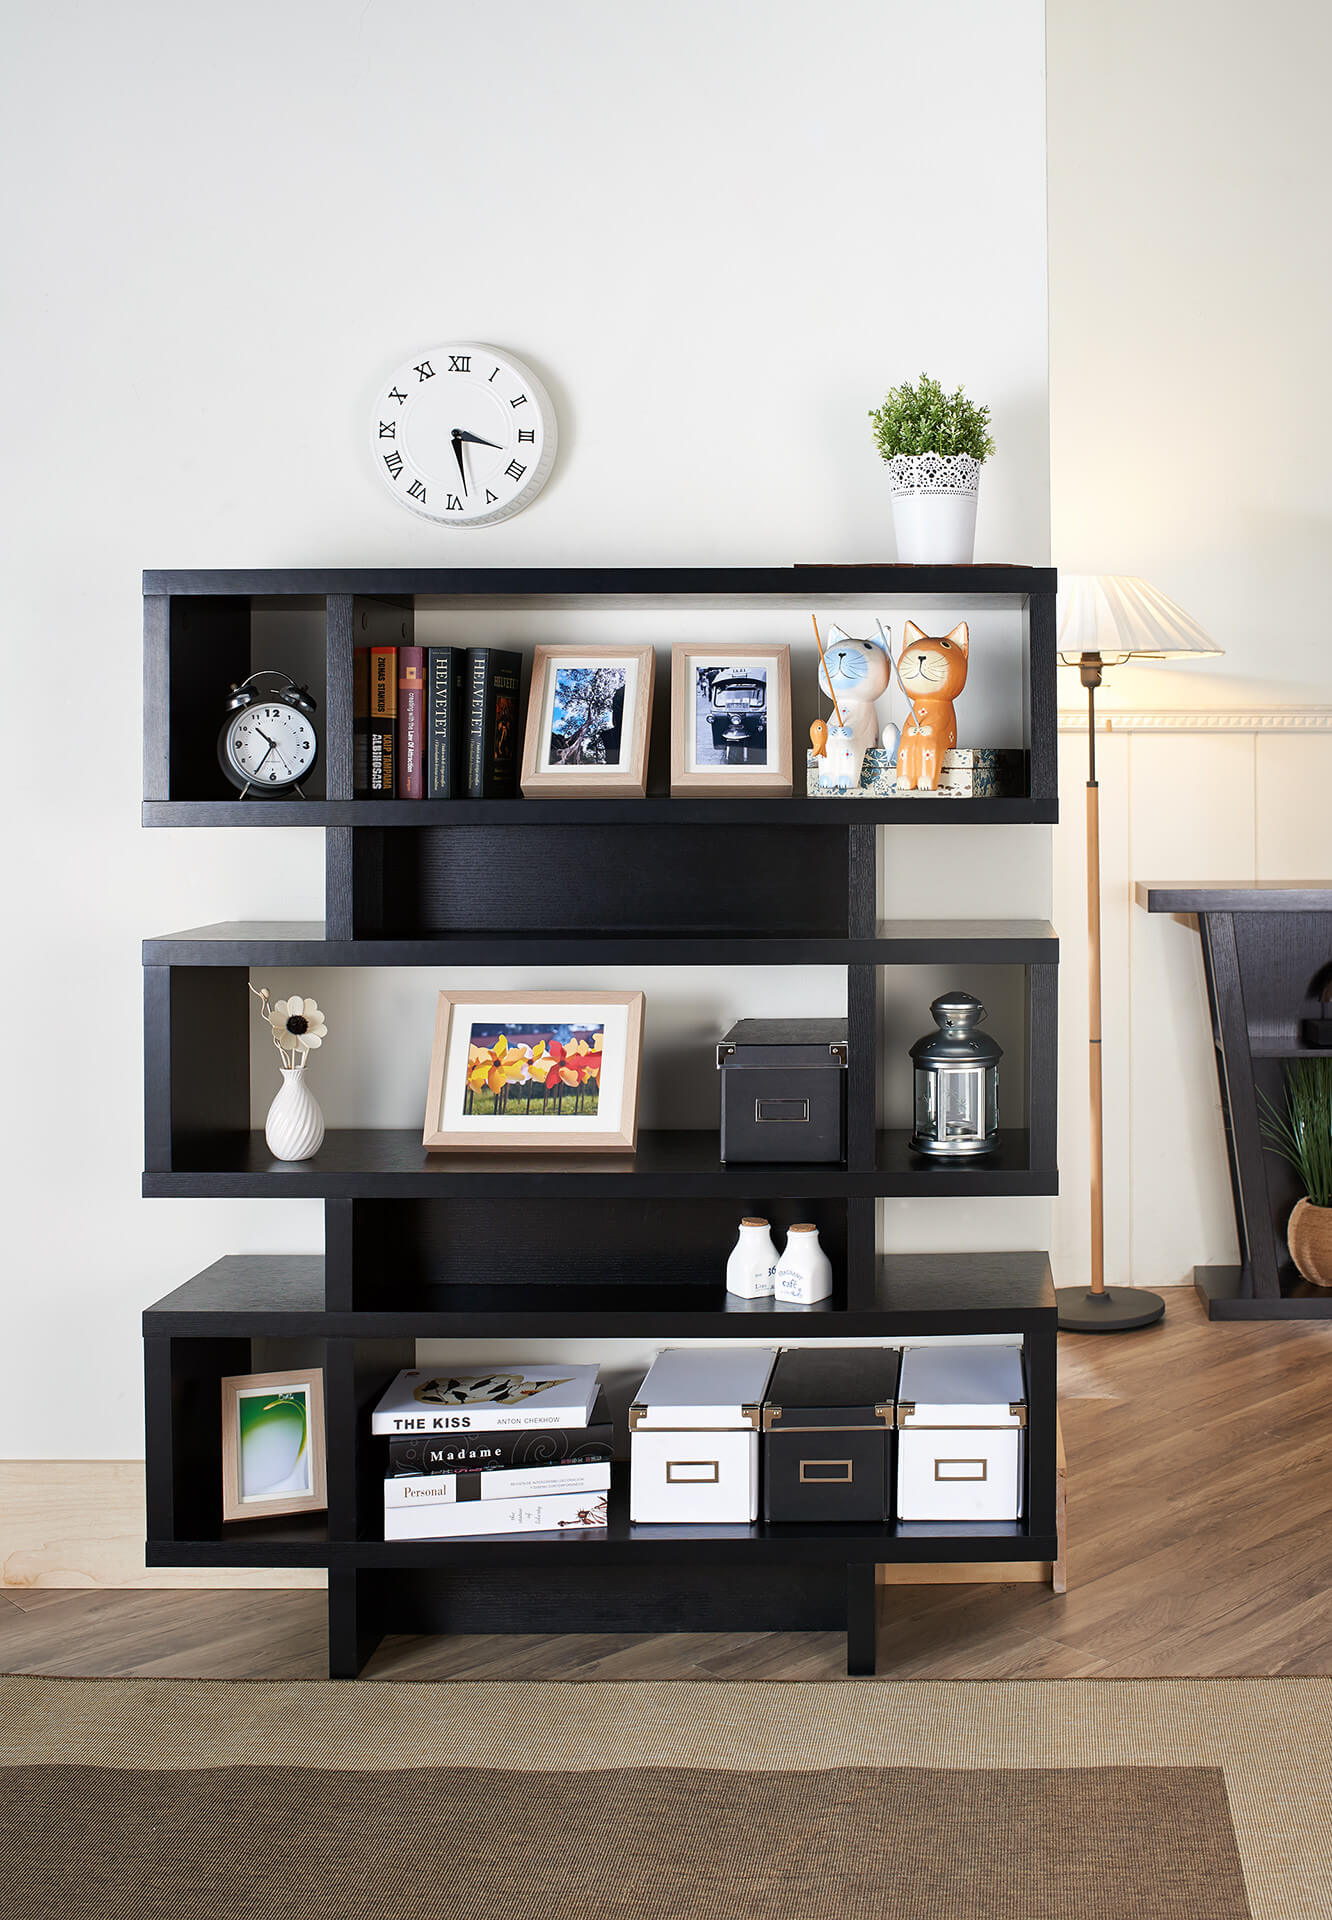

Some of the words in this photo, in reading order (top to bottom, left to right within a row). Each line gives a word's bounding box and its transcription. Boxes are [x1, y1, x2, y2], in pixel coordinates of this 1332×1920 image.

[413, 361, 436, 382] XI
[448, 355, 472, 372] XII
[488, 367, 500, 382] I
[388, 386, 408, 405] X
[510, 394, 527, 408] II
[379, 420, 396, 439] IX
[518, 429, 534, 443] III
[383, 450, 404, 480] VIII
[504, 459, 527, 482] IIII
[406, 479, 427, 504] VII
[485, 489, 499, 504] V
[446, 494, 464, 510] VI
[407, 692, 415, 712] creating
[434, 658, 448, 738] HELVETET
[470, 658, 486, 737] HELVETET
[265, 709, 280, 718] 12
[383, 734, 393, 752] KAIP
[407, 731, 415, 741] Law
[303, 742, 310, 750] 3
[407, 748, 415, 773] Attraction
[269, 773, 277, 781] 6
[393, 1418, 426, 1430] THE
[433, 1416, 471, 1429] KISS
[496, 1417, 522, 1425] ANTON
[523, 1416, 561, 1424] CHEKHOW
[430, 1447, 503, 1462] Madame
[404, 1484, 447, 1498] Personal
